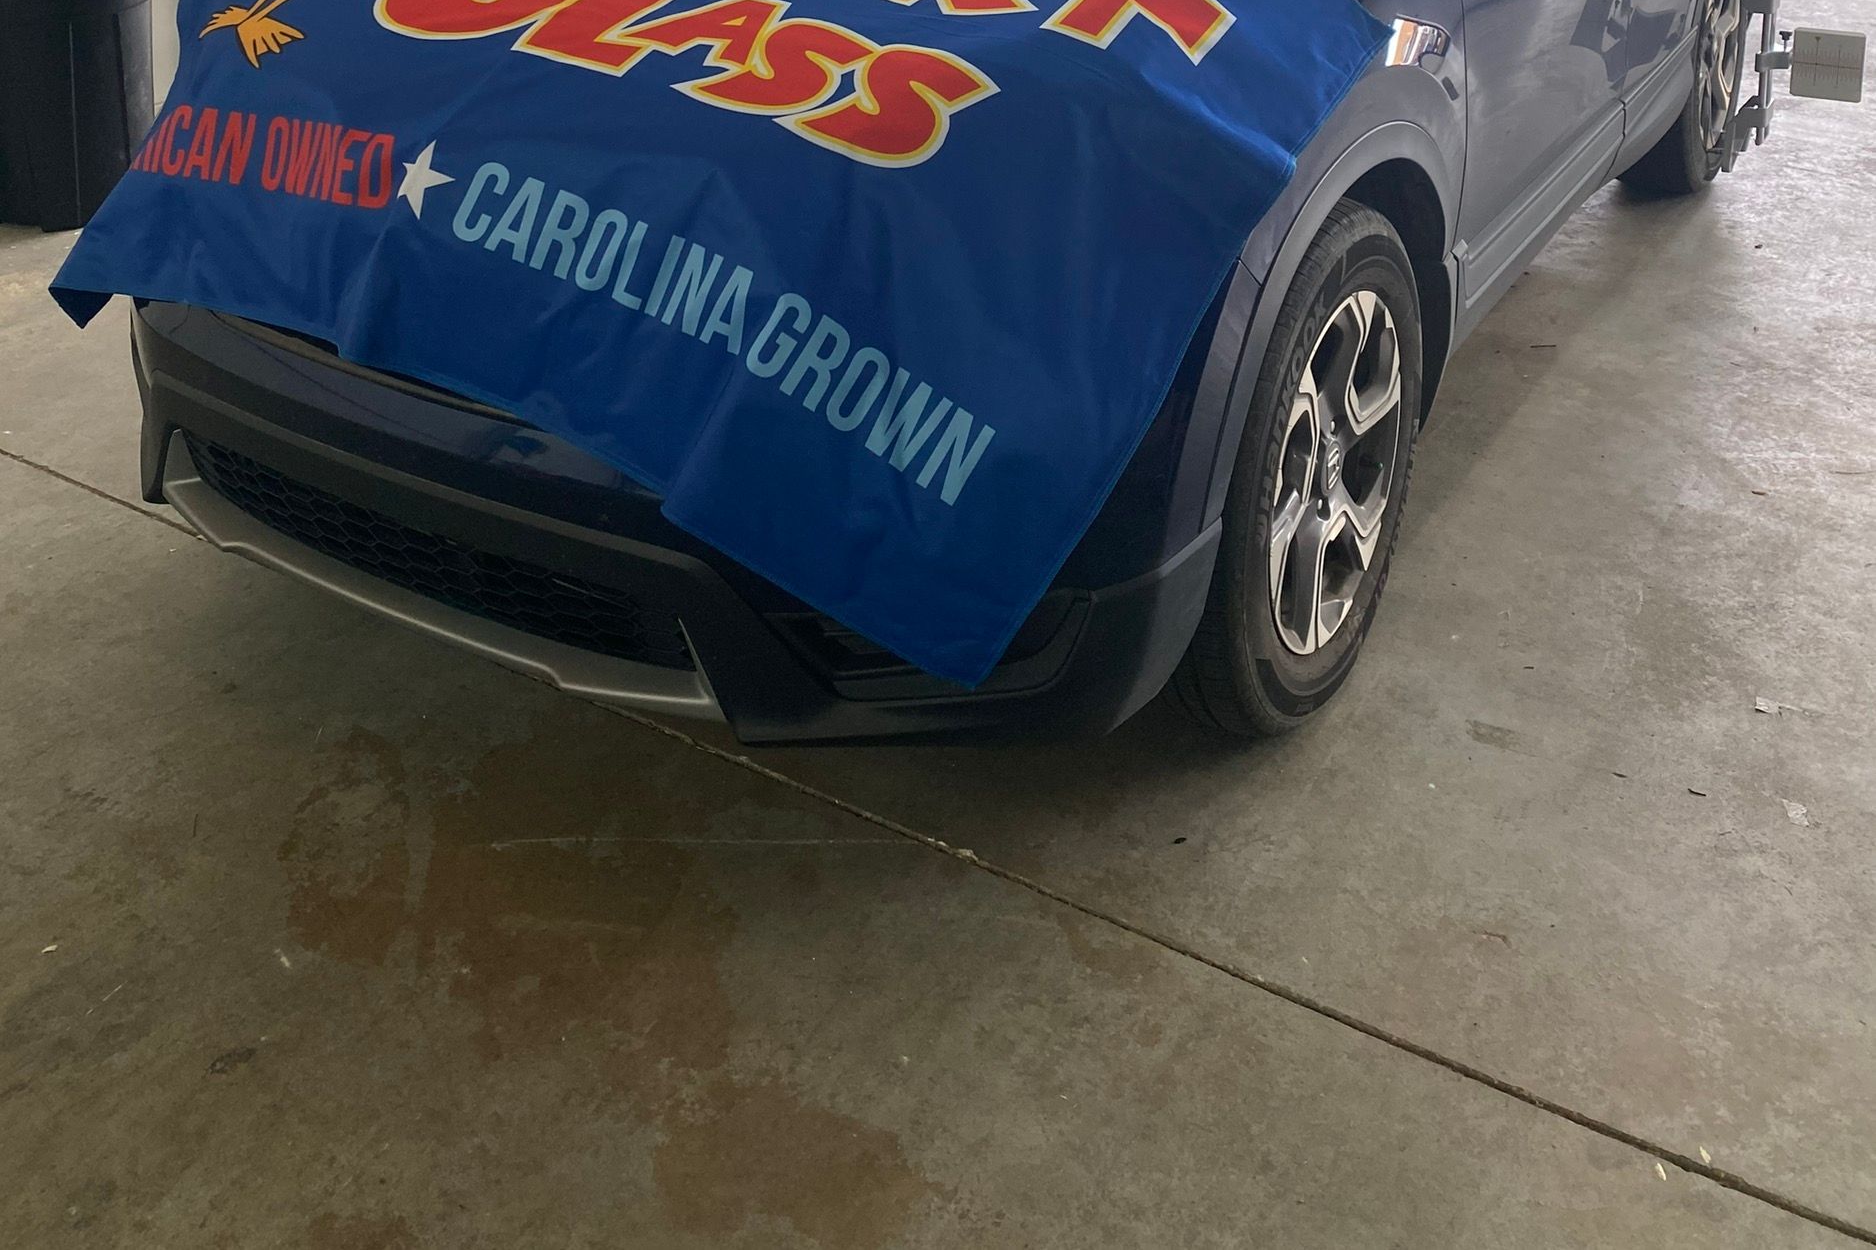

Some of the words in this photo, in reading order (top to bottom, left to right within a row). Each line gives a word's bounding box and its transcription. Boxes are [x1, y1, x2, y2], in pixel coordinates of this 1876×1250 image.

[261, 116, 395, 209] OWNED
[452, 161, 754, 356] CAROLINA
[745, 292, 996, 506] GROWN
